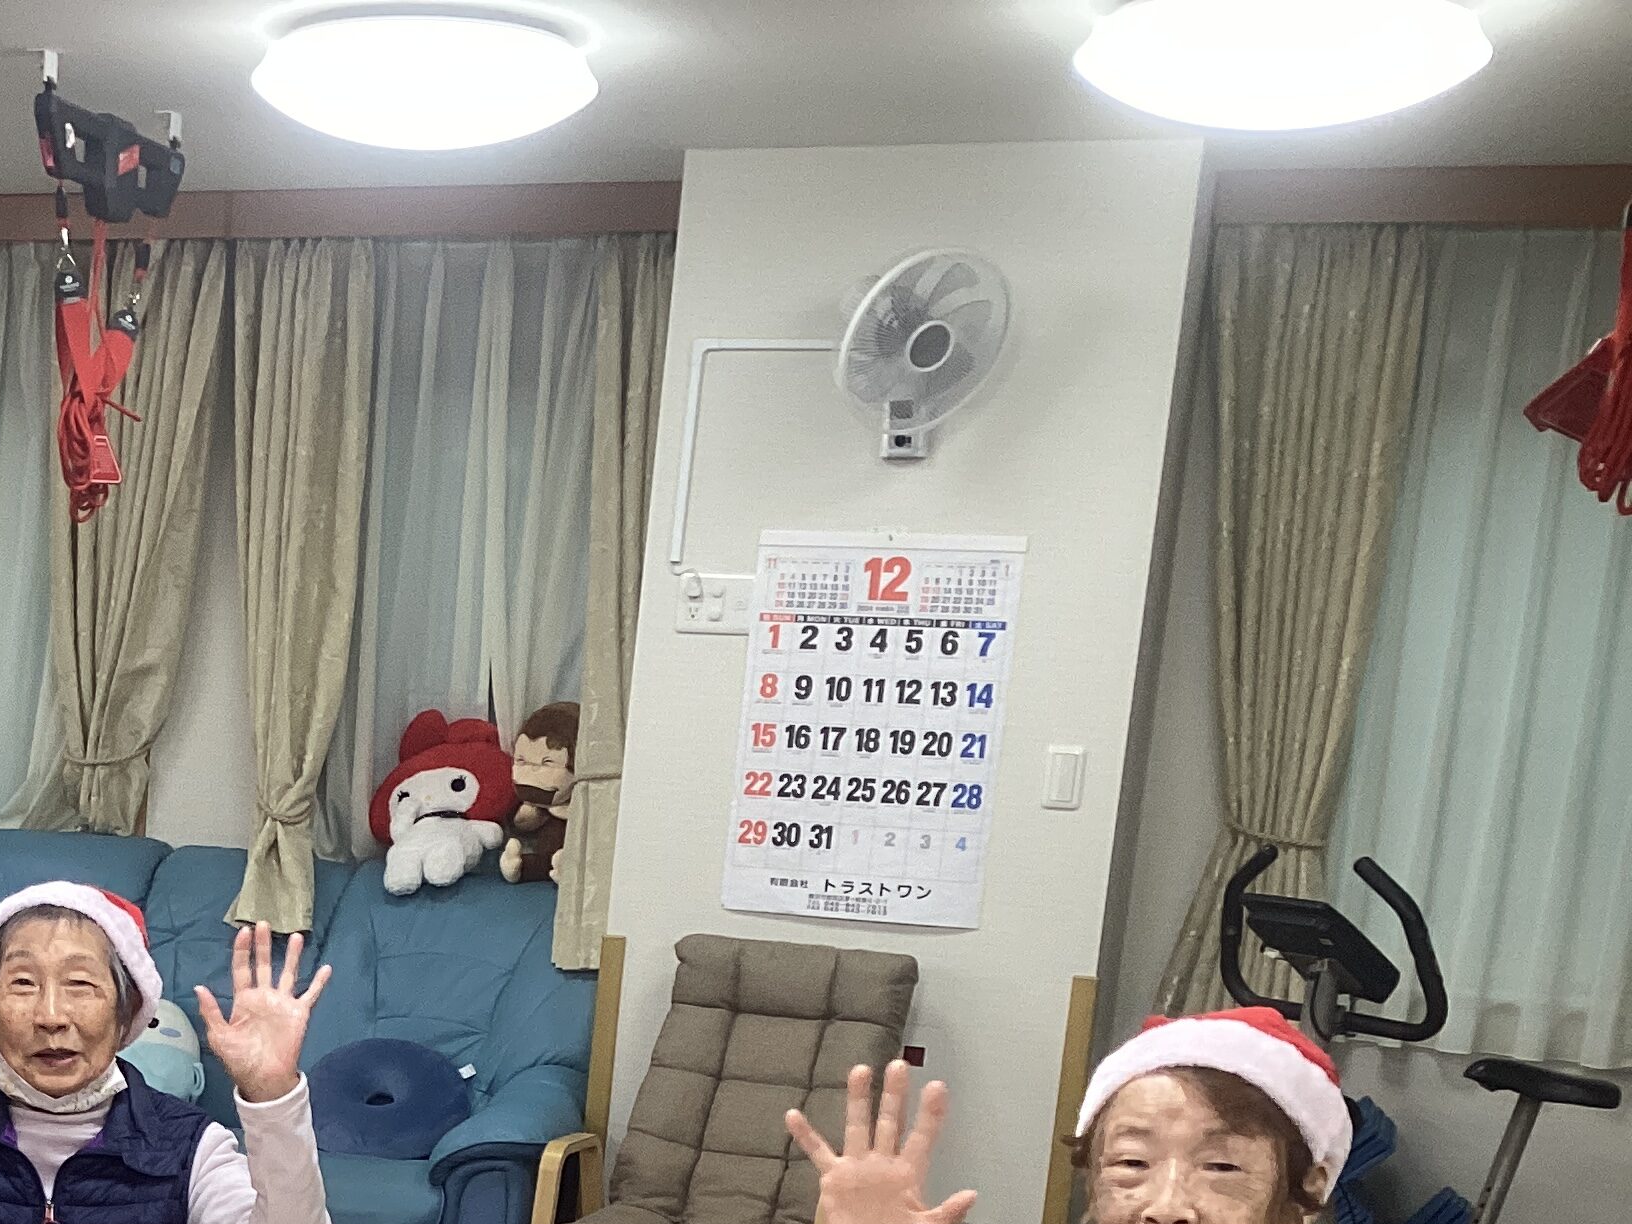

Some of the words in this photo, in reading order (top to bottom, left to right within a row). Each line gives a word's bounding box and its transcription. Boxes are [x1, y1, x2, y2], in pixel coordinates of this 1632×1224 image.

[864, 557, 911, 601] 12
[769, 624, 780, 648] 1
[800, 626, 818, 649] 2
[835, 627, 853, 651] 3
[870, 629, 887, 652] 4
[905, 630, 923, 653] 5
[938, 631, 959, 655] 6
[978, 632, 996, 656] 7
[760, 674, 778, 698] 8
[795, 675, 812, 699] 9
[826, 677, 852, 701] 10
[863, 679, 885, 702] 11
[896, 680, 922, 704] 12
[931, 682, 957, 706] 13
[967, 683, 994, 708] 14
[752, 723, 776, 748] 15
[786, 725, 811, 749] 16
[820, 727, 847, 751] 17
[856, 728, 880, 752] 18
[890, 730, 915, 755] 19
[922, 731, 952, 757] 20
[960, 733, 986, 758] 21
[744, 772, 772, 796] 22
[777, 774, 806, 798] 23
[811, 776, 841, 800] 24
[846, 777, 876, 802] 25
[881, 780, 911, 804] 26
[916, 782, 947, 806] 27
[951, 784, 982, 809] 28
[738, 820, 767, 845] 29
[772, 822, 800, 847] 30
[809, 824, 833, 849] 31
[852, 830, 860, 845] 1
[884, 832, 896, 846] 2
[919, 835, 932, 850] 3
[955, 837, 967, 851] 4
[824, 878, 932, 900] トラストワン
